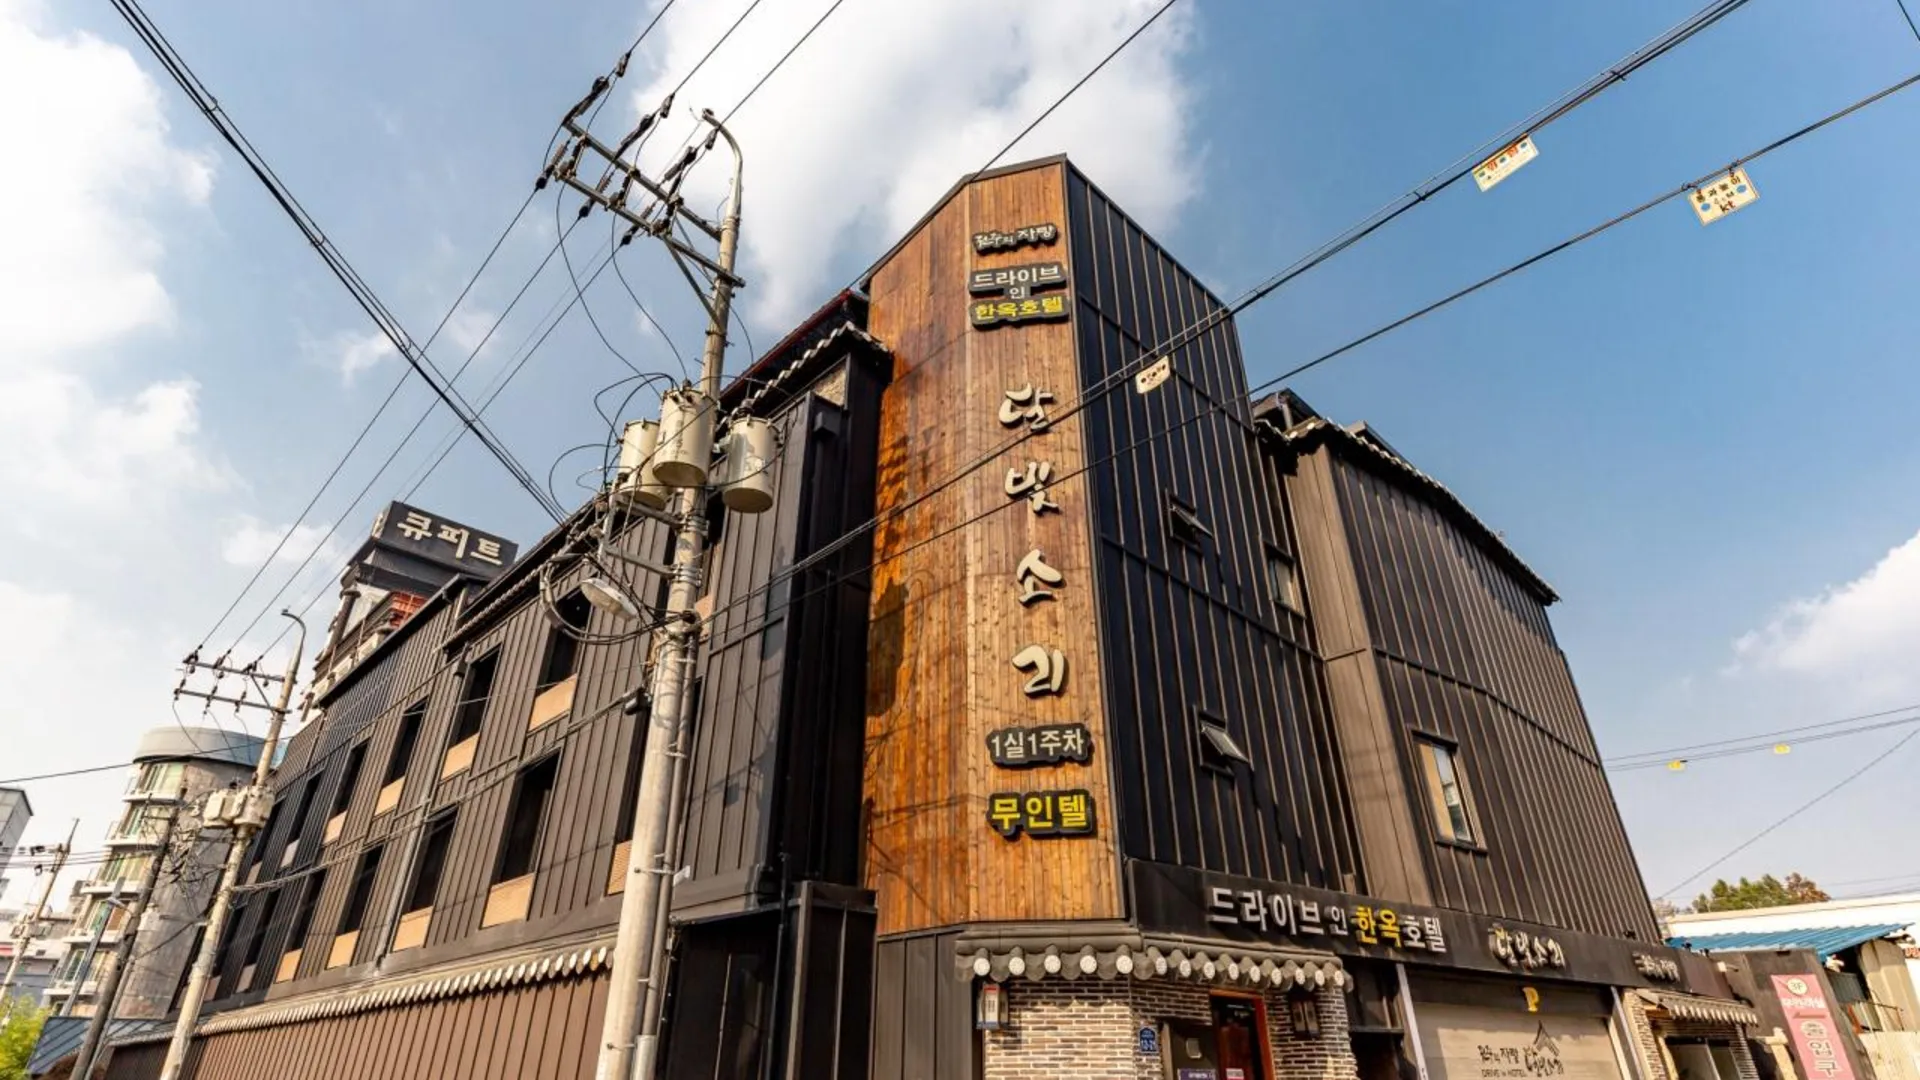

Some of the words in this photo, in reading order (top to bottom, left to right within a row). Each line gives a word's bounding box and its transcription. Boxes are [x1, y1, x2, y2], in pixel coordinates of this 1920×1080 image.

[1719, 200, 1736, 213] kt
[1017, 224, 1054, 241] 자랑
[974, 265, 1062, 289] 드라이브
[1009, 286, 1026, 300] 인
[974, 296, 1064, 321] 한옥호텔
[397, 511, 503, 566] 큐피트
[991, 794, 1088, 831] 무인텔
[1207, 886, 1325, 936] 드라이브
[1327, 906, 1349, 936] 인
[1523, 986, 1540, 1013] P
